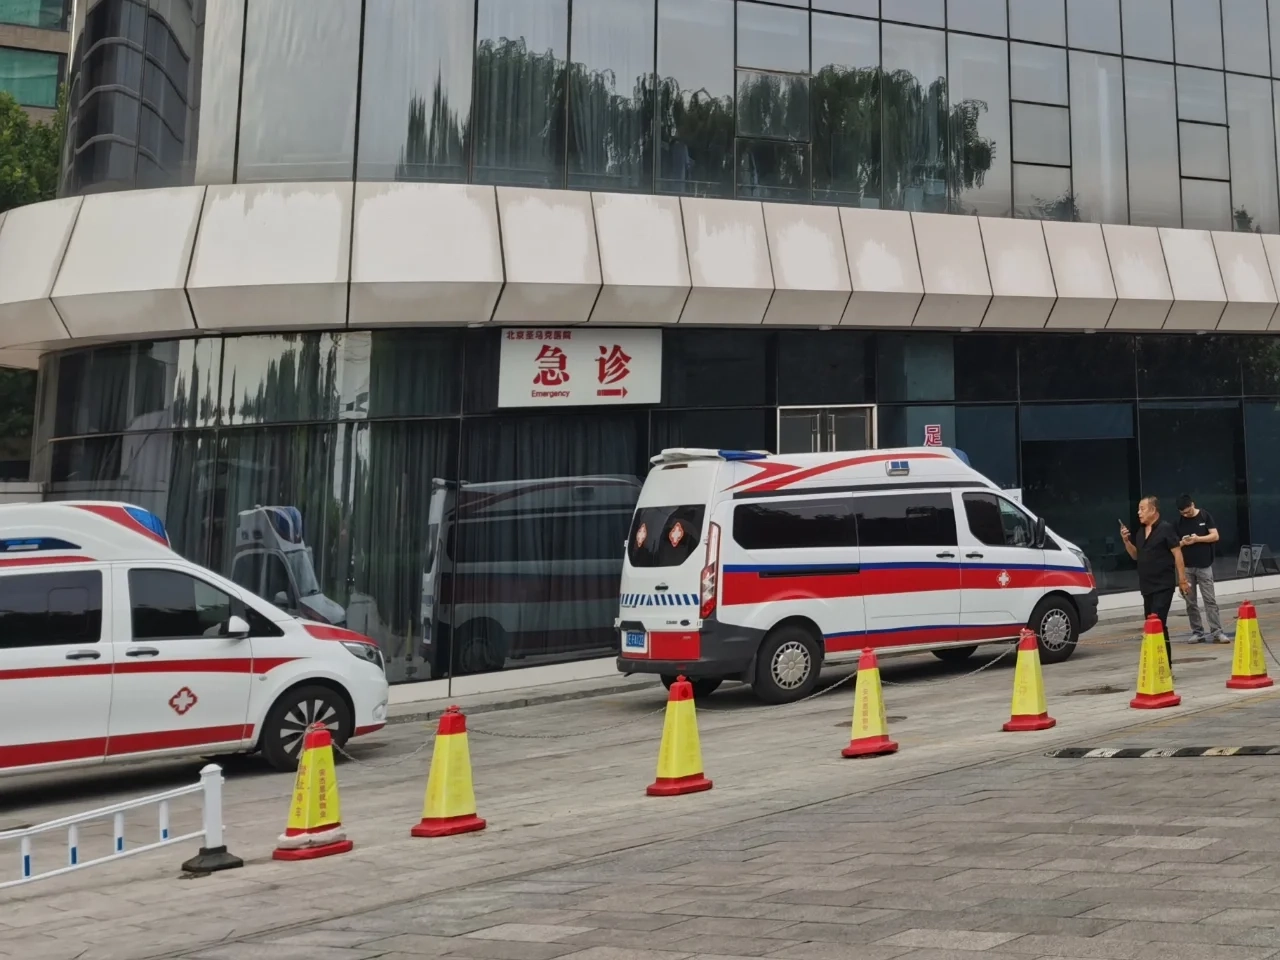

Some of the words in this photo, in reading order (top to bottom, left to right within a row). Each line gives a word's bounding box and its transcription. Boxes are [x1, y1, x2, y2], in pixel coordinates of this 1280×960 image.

[506, 330, 572, 341] 北京圣马克医院
[531, 389, 571, 399] Emergency
